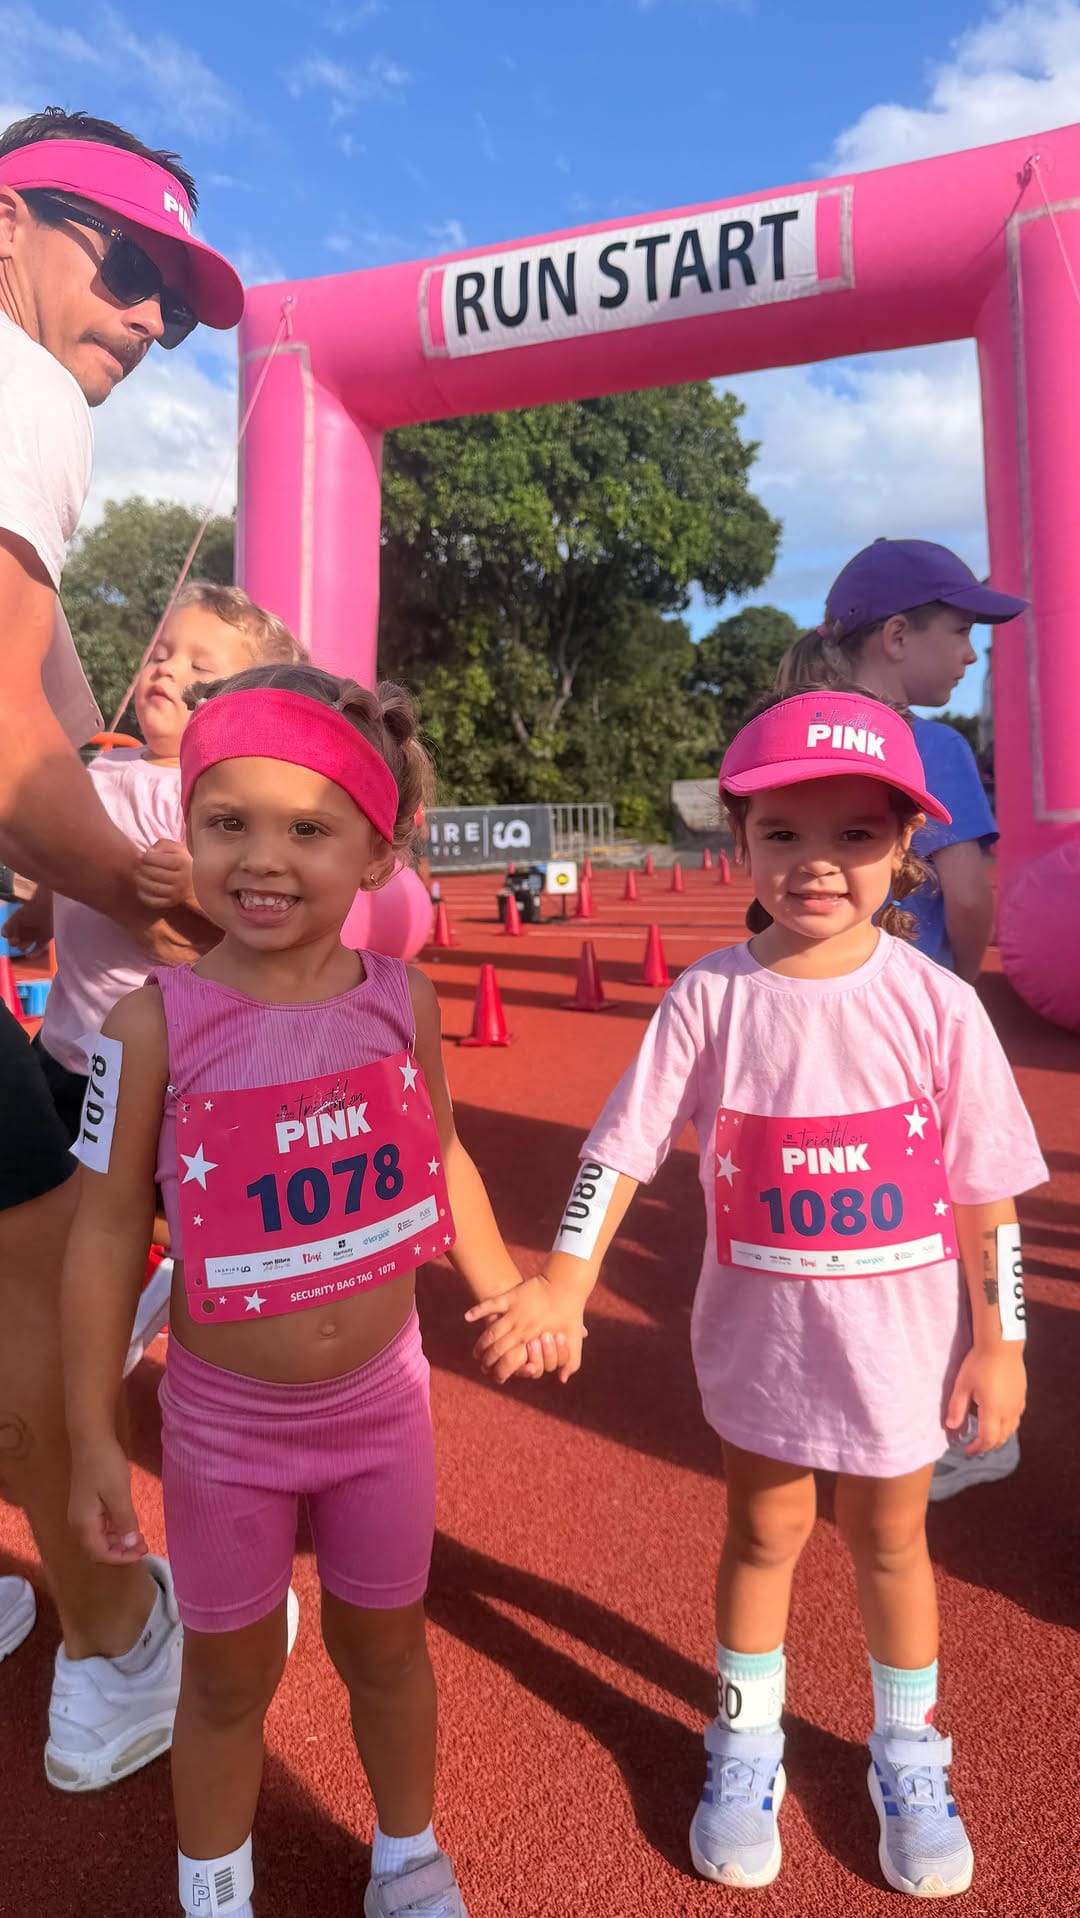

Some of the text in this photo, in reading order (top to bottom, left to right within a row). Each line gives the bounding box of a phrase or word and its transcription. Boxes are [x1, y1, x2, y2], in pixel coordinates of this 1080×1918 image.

[163, 190, 191, 235] PIN
[454, 209, 799, 336] RUN START
[806, 723, 886, 761] PINK
[430, 821, 481, 844] IRE
[82, 1052, 107, 1145] 1078
[275, 1102, 372, 1154] PINK
[781, 1143, 872, 1175] PINK
[246, 1143, 405, 1233] 1078
[560, 1162, 604, 1237] 1080
[759, 1183, 904, 1237] 1080
[290, 1261, 396, 1302] SECURITY BAG TAG 1078
